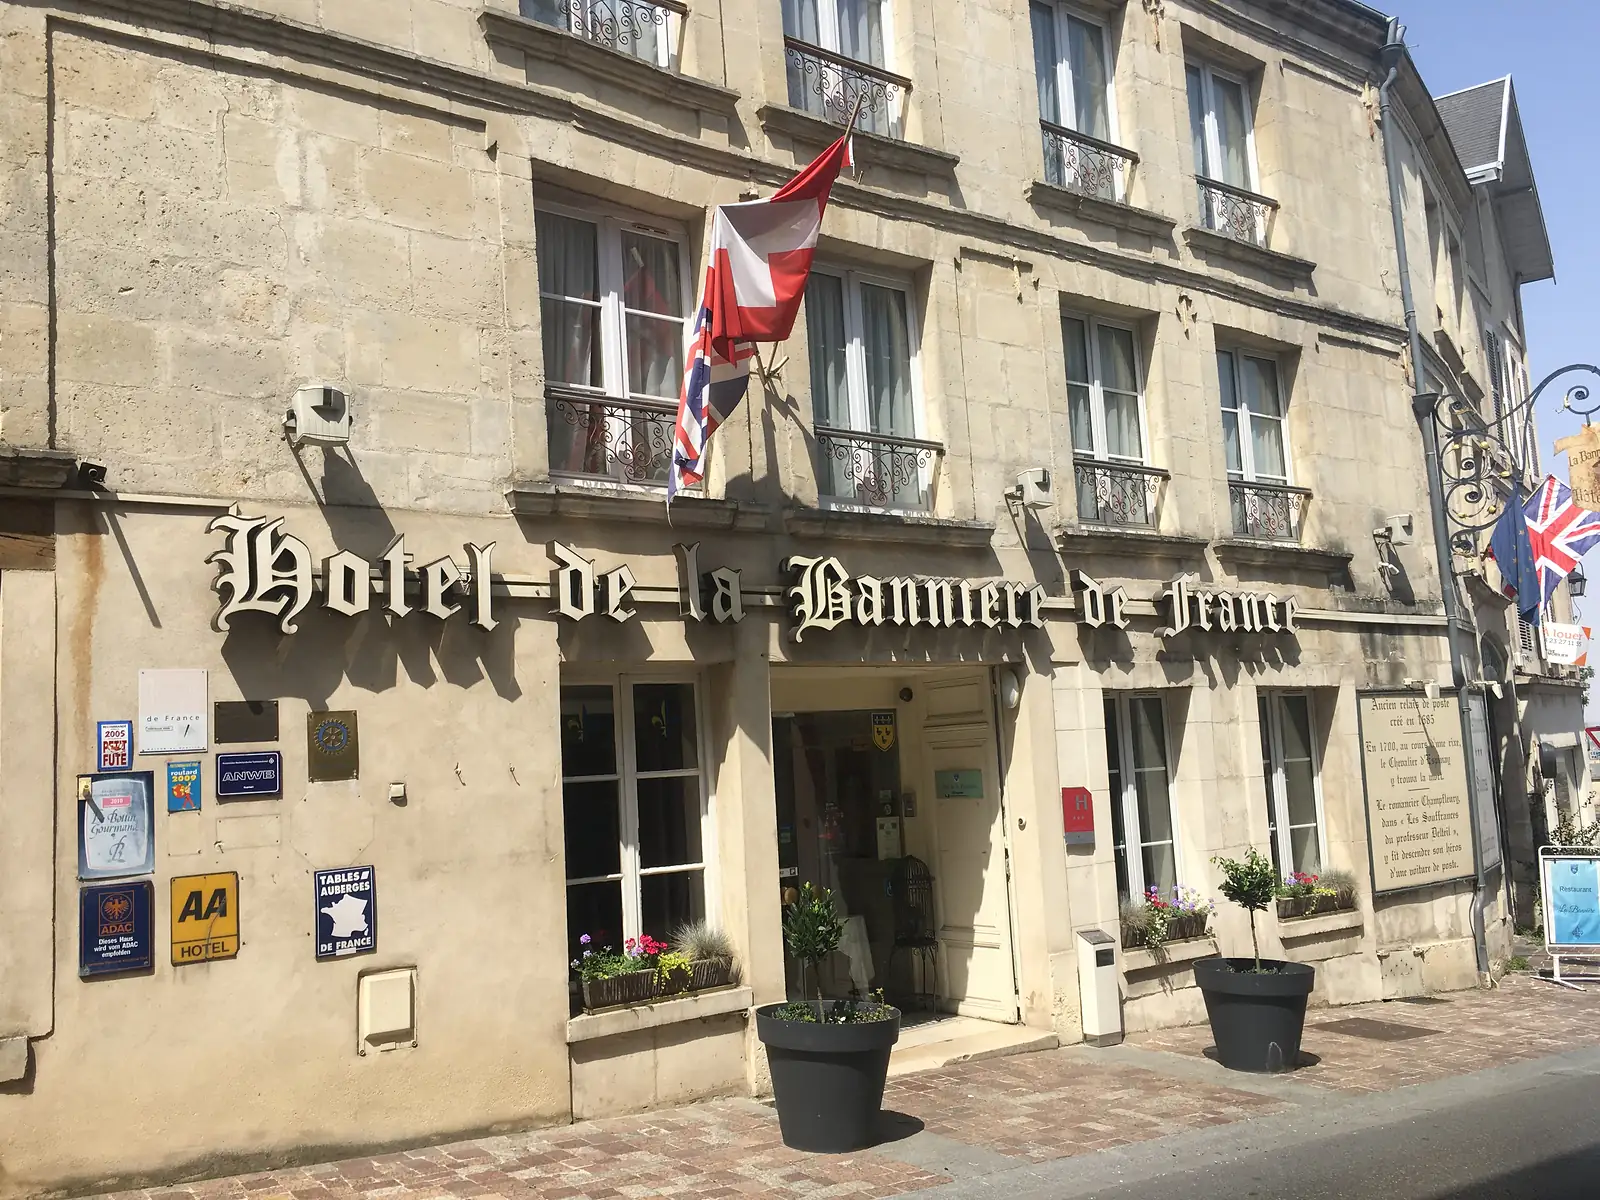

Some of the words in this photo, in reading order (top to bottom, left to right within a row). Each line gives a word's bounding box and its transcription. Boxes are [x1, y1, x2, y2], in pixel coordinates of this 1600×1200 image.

[204, 511, 500, 635] Hotel
[546, 539, 638, 624] de
[672, 541, 747, 624] la
[1070, 568, 1132, 629] de
[1153, 571, 1303, 638] France
[1553, 629, 1583, 640] louer
[1371, 697, 1397, 710] Ancien
[1400, 698, 1419, 710] relais
[1421, 698, 1430, 709] de
[1433, 698, 1450, 711] poste
[1390, 715, 1404, 726] créé
[1406, 717, 1415, 726] en
[105, 730, 126, 738] 2005
[1365, 741, 1376, 753] En
[1380, 758, 1386, 769] le
[1388, 756, 1418, 770] Chevalier
[170, 768, 198, 776] routard
[171, 774, 197, 782] 2009
[222, 769, 276, 782] ANWB
[1390, 778, 1395, 787] y
[1420, 772, 1426, 782] la
[1075, 794, 1088, 811] H
[1376, 799, 1386, 811] Le
[1389, 798, 1420, 810] romancier
[1381, 817, 1397, 828] dans
[1406, 813, 1419, 825] Les
[1421, 811, 1459, 823] Souffrances
[1385, 834, 1394, 845] du
[1396, 831, 1429, 846] professeur
[1383, 854, 1389, 865] y
[1401, 847, 1430, 860] descendre
[1432, 846, 1444, 855] son
[1446, 842, 1462, 856] héros
[1389, 867, 1407, 879] d'une
[1409, 865, 1431, 876] voiture
[1432, 862, 1440, 872] de
[319, 872, 360, 886] TABLES
[320, 881, 371, 897] AUBERGES
[1559, 885, 1592, 893] Restaurant
[177, 887, 228, 923] AA
[101, 923, 133, 935] ADAC
[93, 944, 107, 952] wird
[122, 941, 139, 949] ADAC
[181, 941, 230, 959] HOTEL
[320, 942, 333, 953] DE
[336, 936, 371, 950] FRANCE
[101, 949, 131, 958] empfohlen
